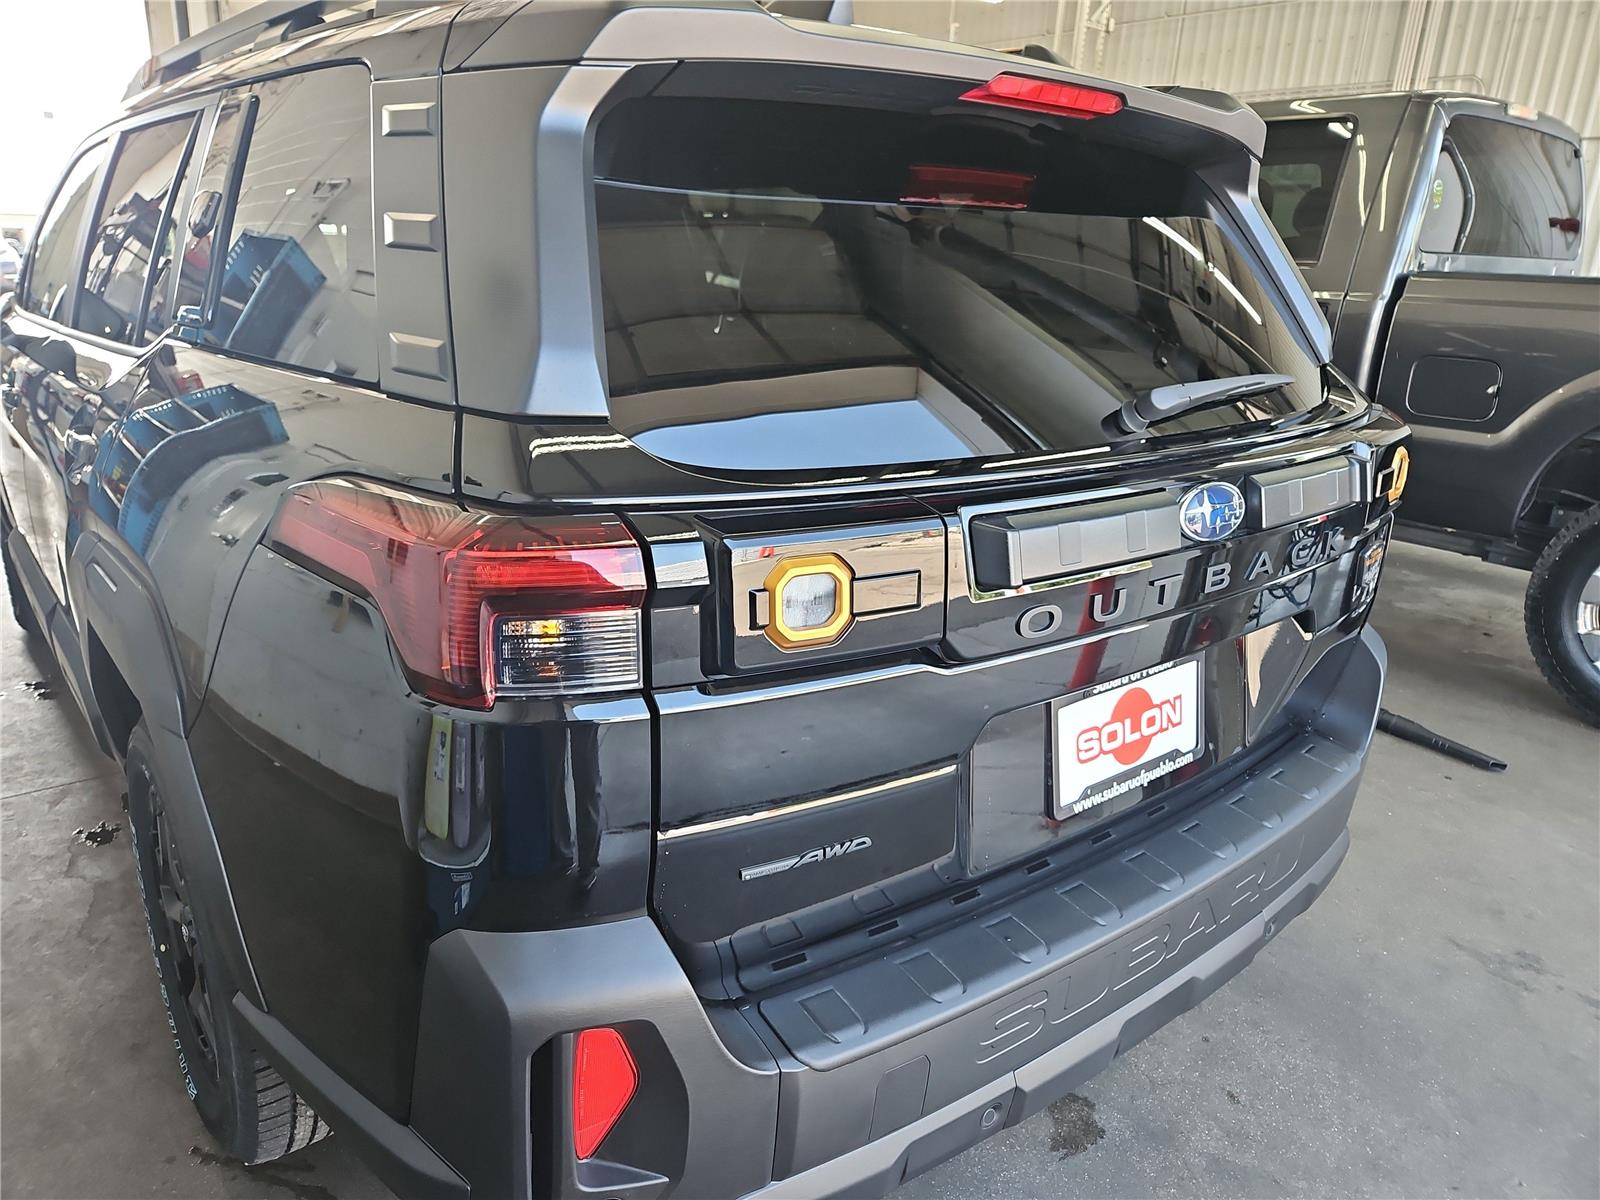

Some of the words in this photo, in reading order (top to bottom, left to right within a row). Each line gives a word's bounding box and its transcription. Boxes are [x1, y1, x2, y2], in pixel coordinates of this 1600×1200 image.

[1015, 526, 1345, 639] OUTBACK
[1076, 694, 1183, 765] SOLON
[1072, 752, 1194, 815] www.subaruofpueblo.com
[792, 836, 873, 869] AWD
[975, 833, 1305, 1065] SUBARU
